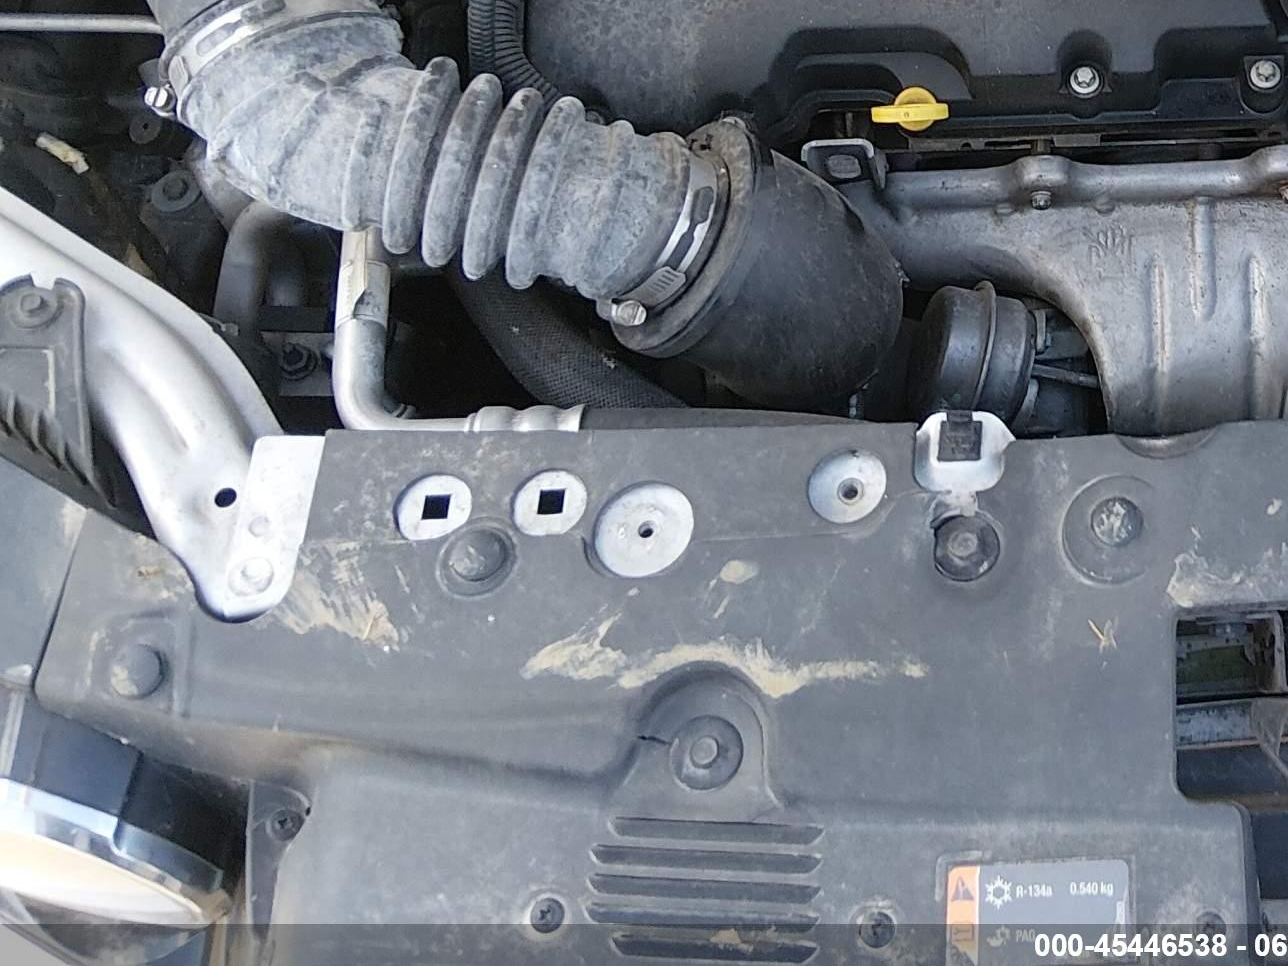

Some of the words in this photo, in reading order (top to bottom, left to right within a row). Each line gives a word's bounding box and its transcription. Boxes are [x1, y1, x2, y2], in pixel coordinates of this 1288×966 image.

[1015, 885, 1053, 898] R-134a
[1069, 882, 1099, 897] 0.540
[1100, 881, 1114, 897] kg
